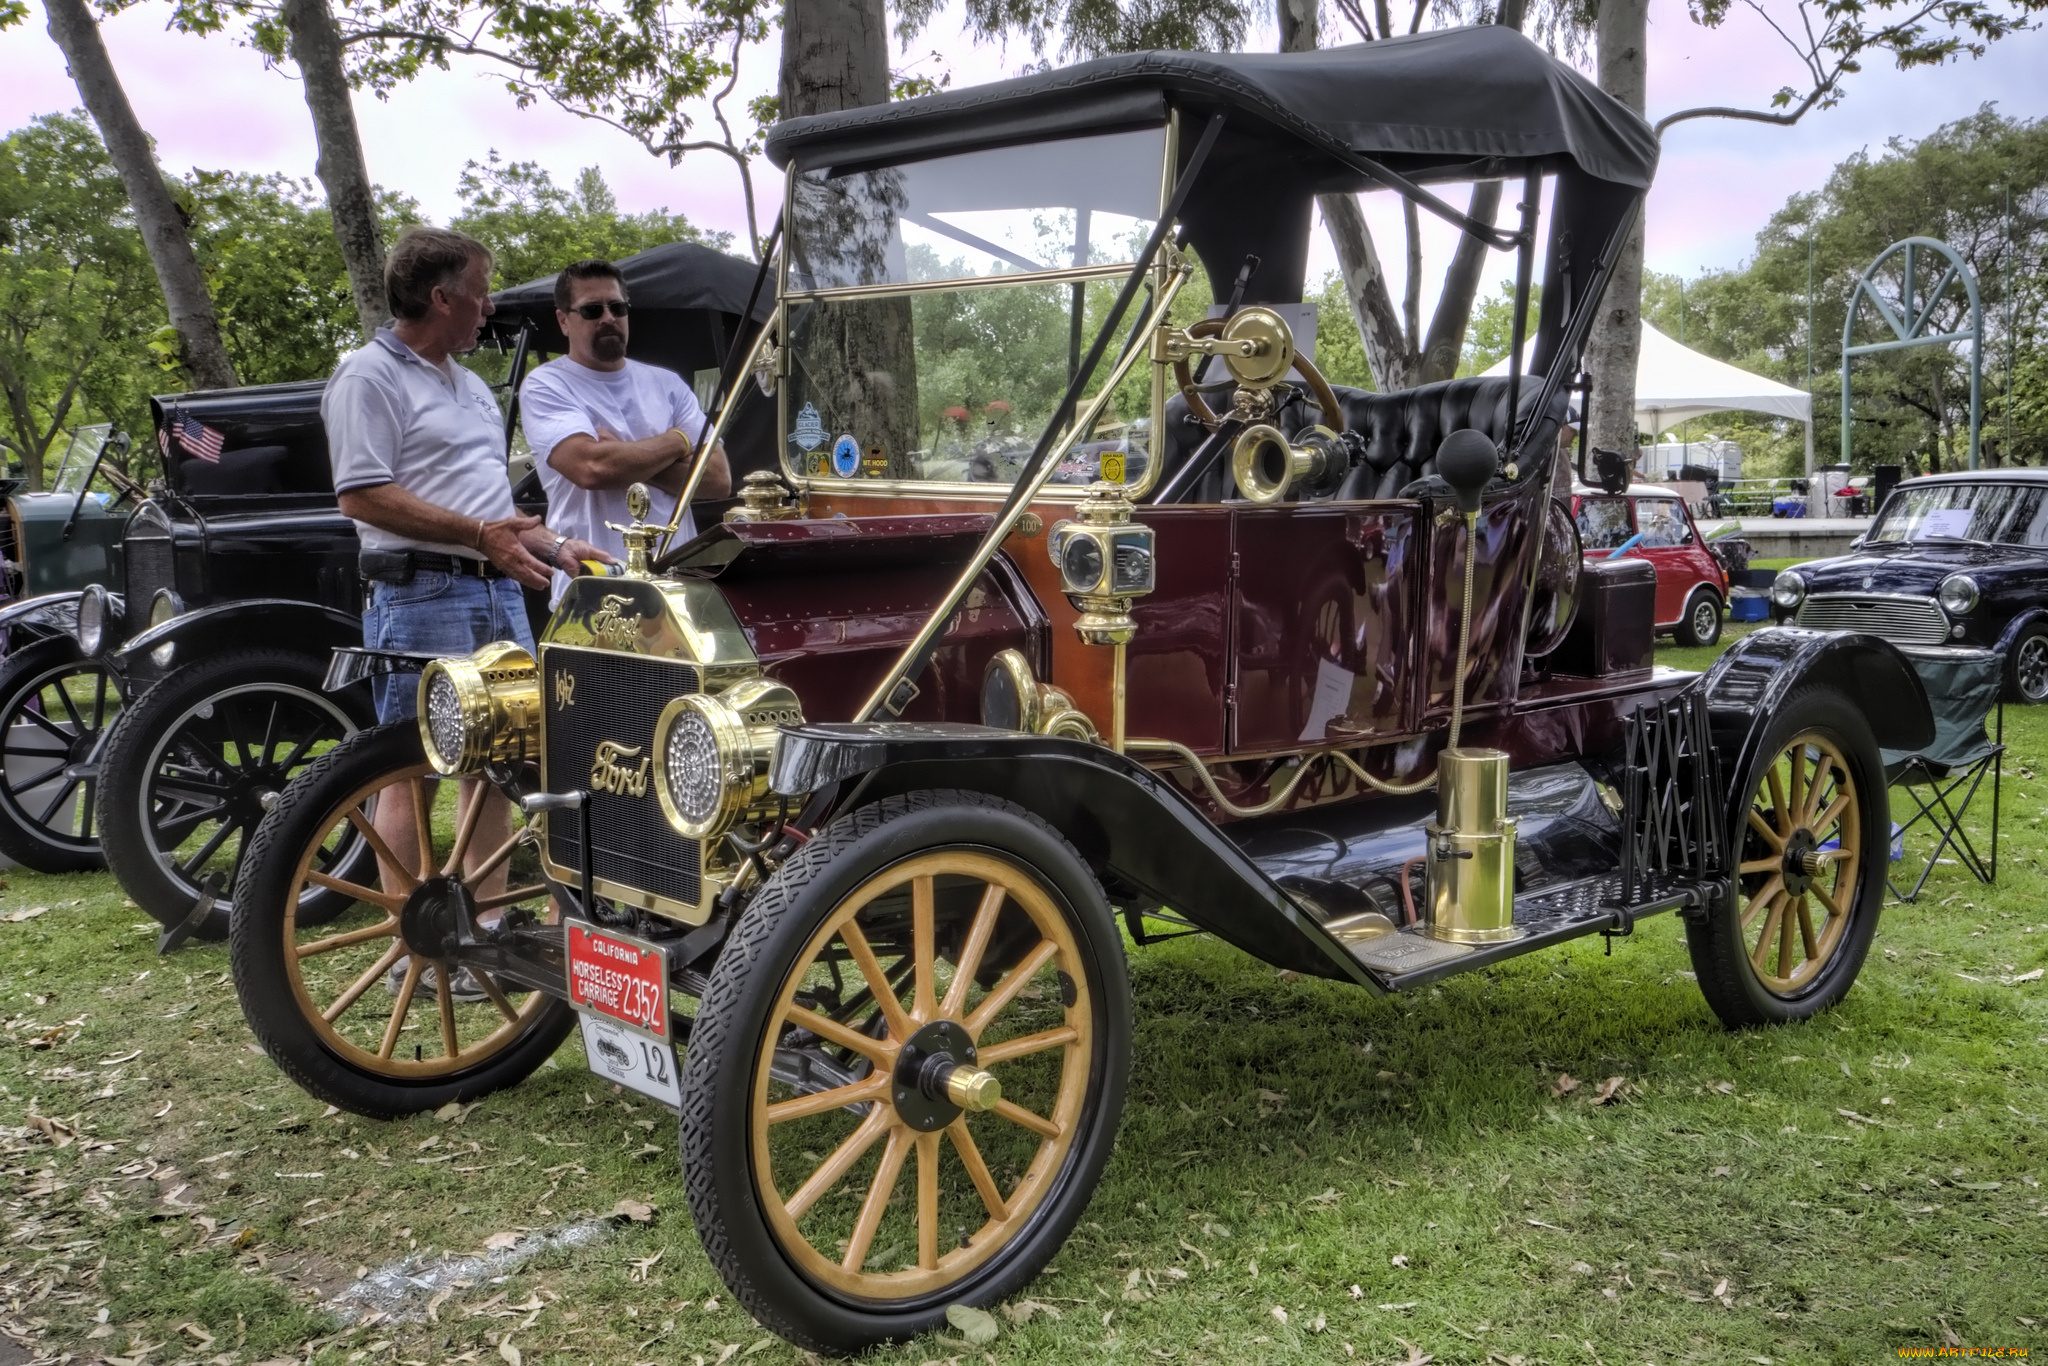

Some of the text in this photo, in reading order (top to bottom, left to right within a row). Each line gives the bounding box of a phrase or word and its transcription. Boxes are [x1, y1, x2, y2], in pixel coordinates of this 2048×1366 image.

[595, 594, 641, 635] Ford
[555, 668, 575, 712] 1912
[590, 740, 650, 798] Ford
[593, 939, 638, 966] CALIFORNIA
[573, 958, 623, 991] HORSELESS
[578, 979, 620, 1010] CARRIAGE
[623, 974, 661, 1027] 2352
[640, 1042, 670, 1087] 12
